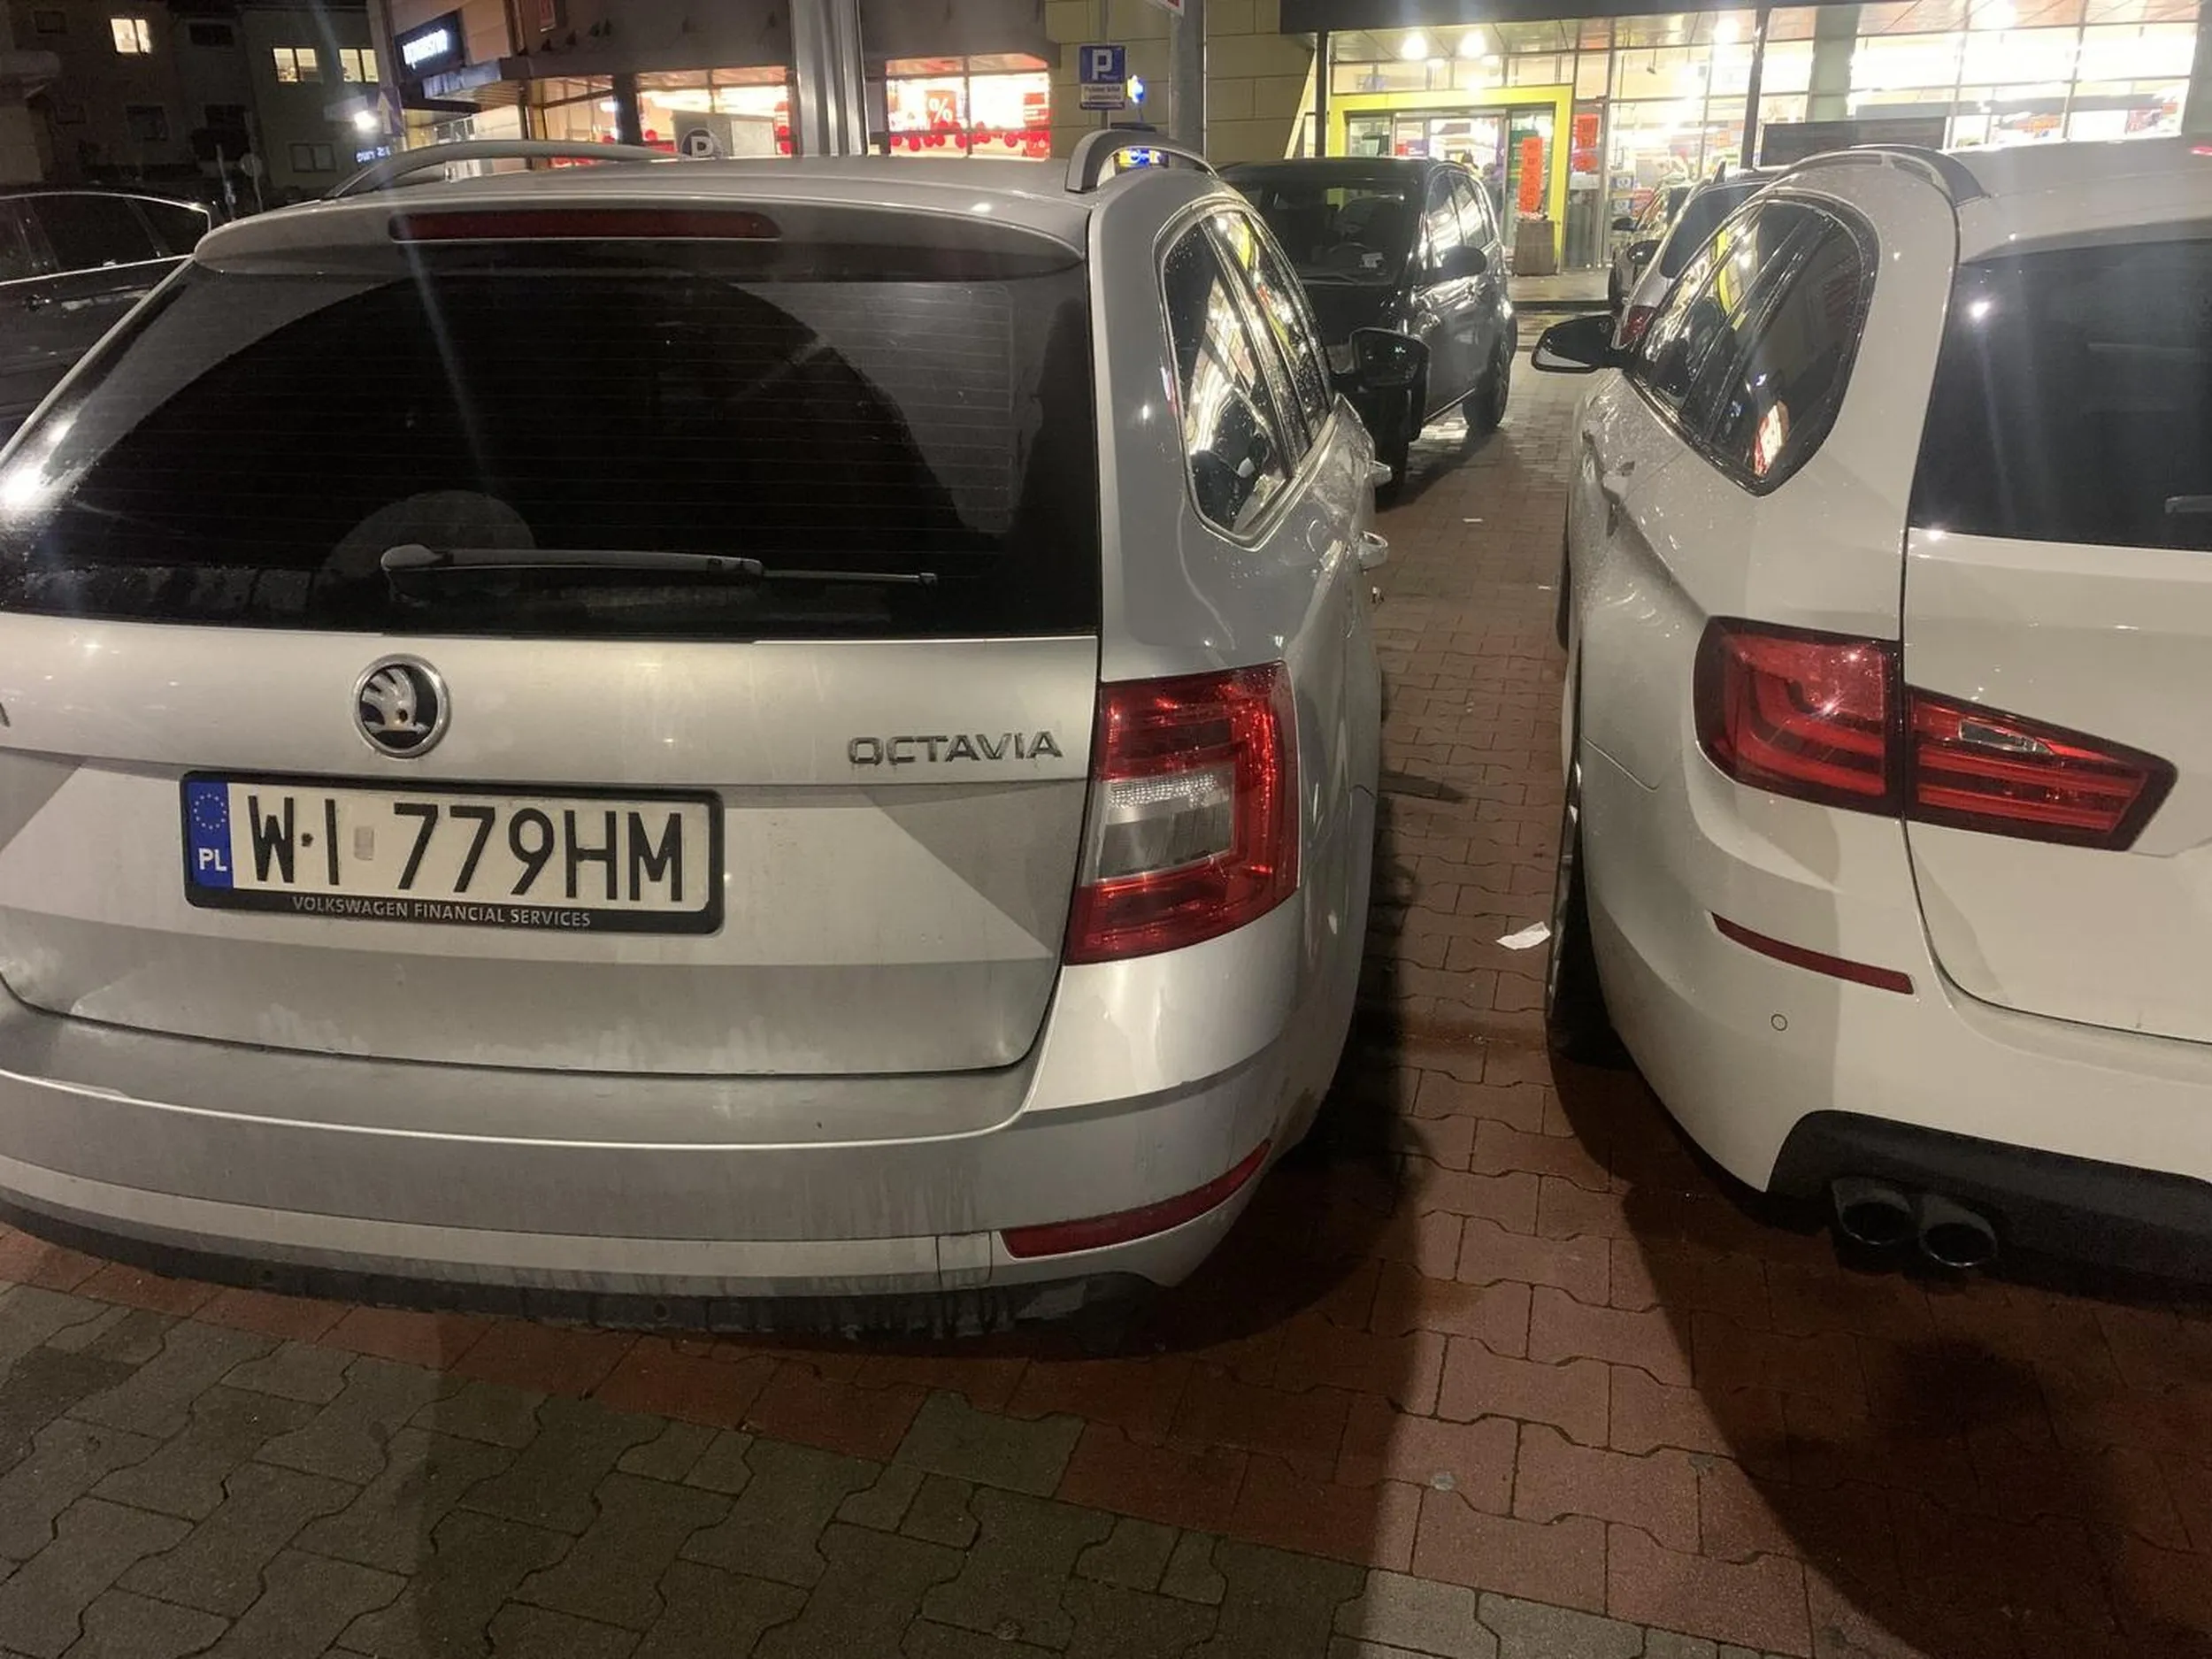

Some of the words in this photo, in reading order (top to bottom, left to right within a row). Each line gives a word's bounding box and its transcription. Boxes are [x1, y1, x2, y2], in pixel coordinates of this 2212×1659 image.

[1092, 50, 1112, 80] P
[848, 731, 1064, 765] OCTAVIA
[199, 849, 227, 872] PL
[248, 795, 340, 886] WI
[394, 803, 682, 902] 779HM
[293, 896, 409, 918] VOLKSWAGEN
[414, 903, 505, 923] FINANCIAL
[510, 910, 591, 927] SERVICES
